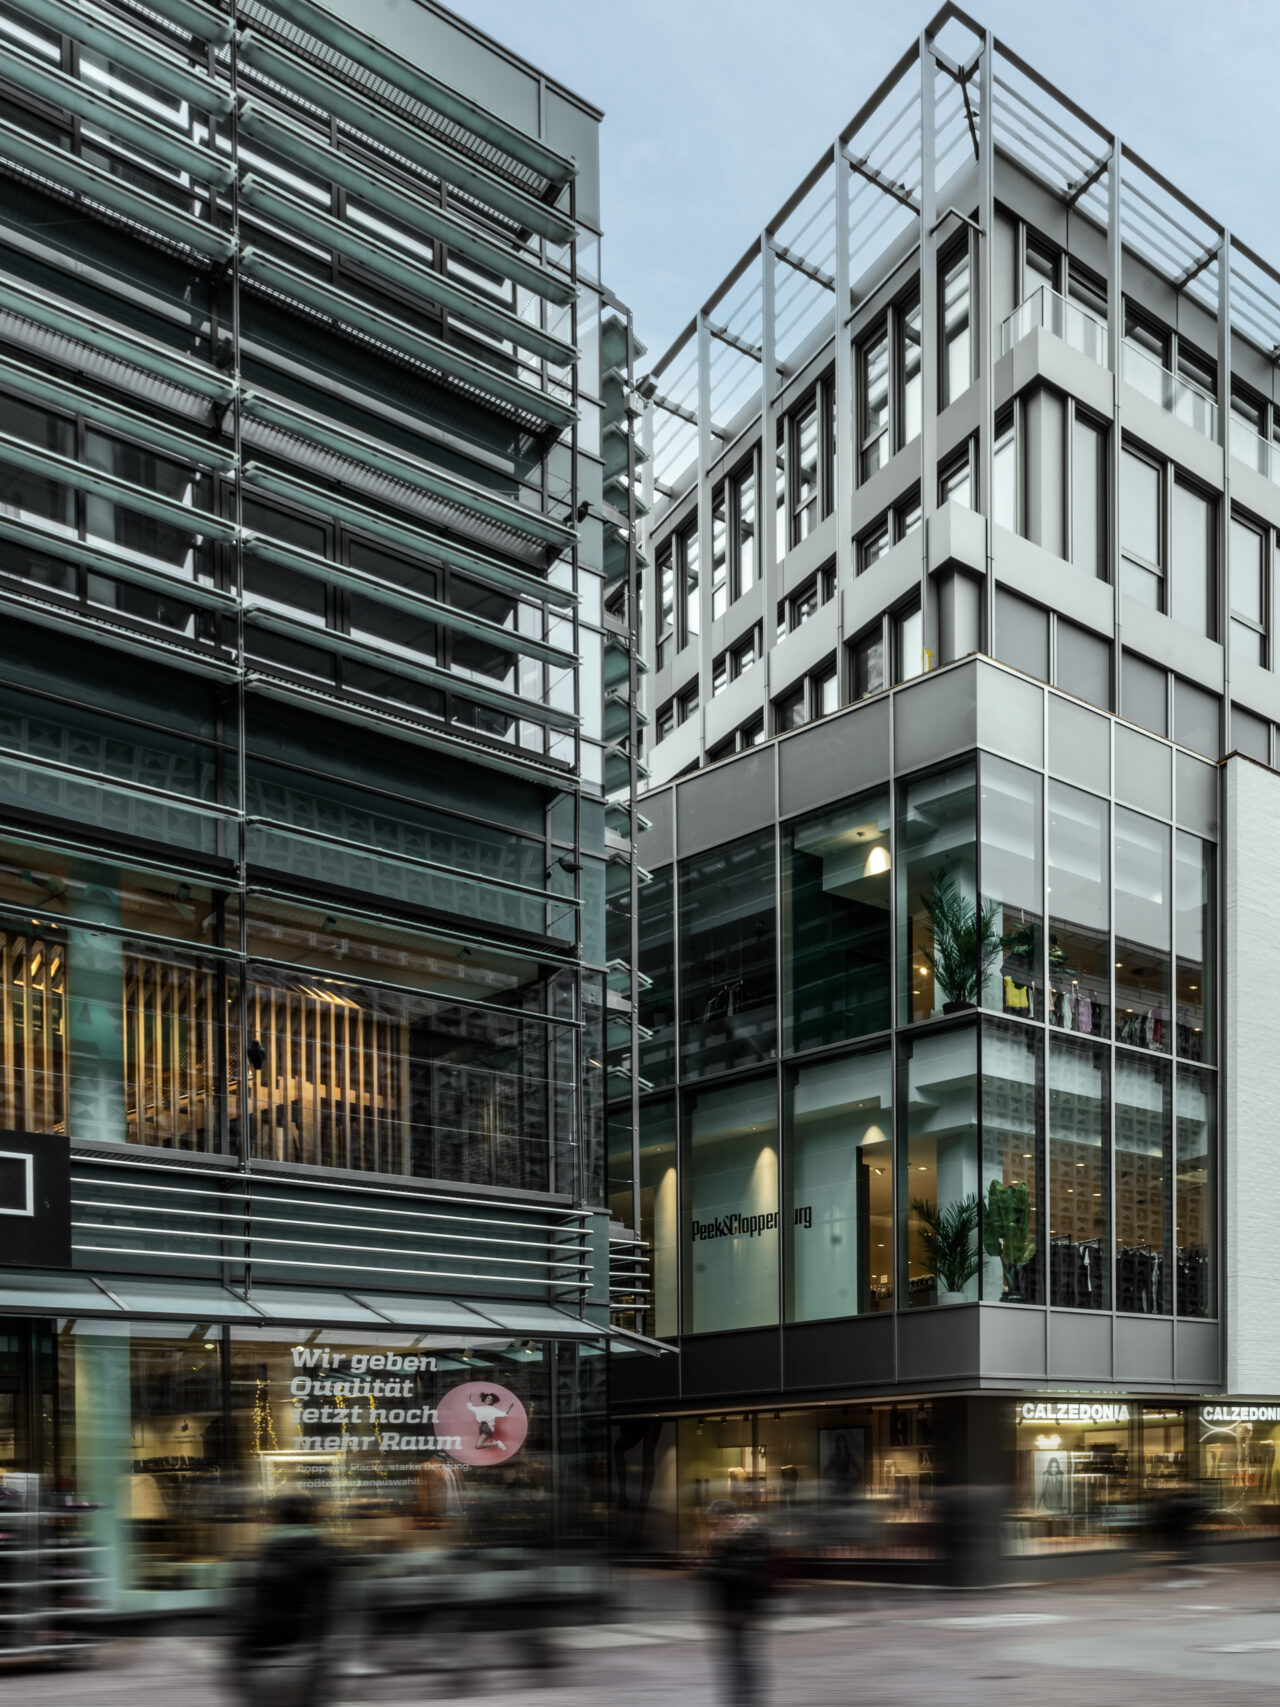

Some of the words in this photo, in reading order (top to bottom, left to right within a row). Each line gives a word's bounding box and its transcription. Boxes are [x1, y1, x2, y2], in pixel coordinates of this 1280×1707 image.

[290, 1347, 346, 1369] Wir
[350, 1352, 438, 1373] geben
[290, 1376, 413, 1401] Qualität
[291, 1402, 363, 1426] jetzt
[369, 1406, 439, 1424] noch
[1022, 1403, 1130, 1420] CALZEDONIA
[293, 1432, 375, 1450] mehr
[380, 1432, 463, 1450] Raum
